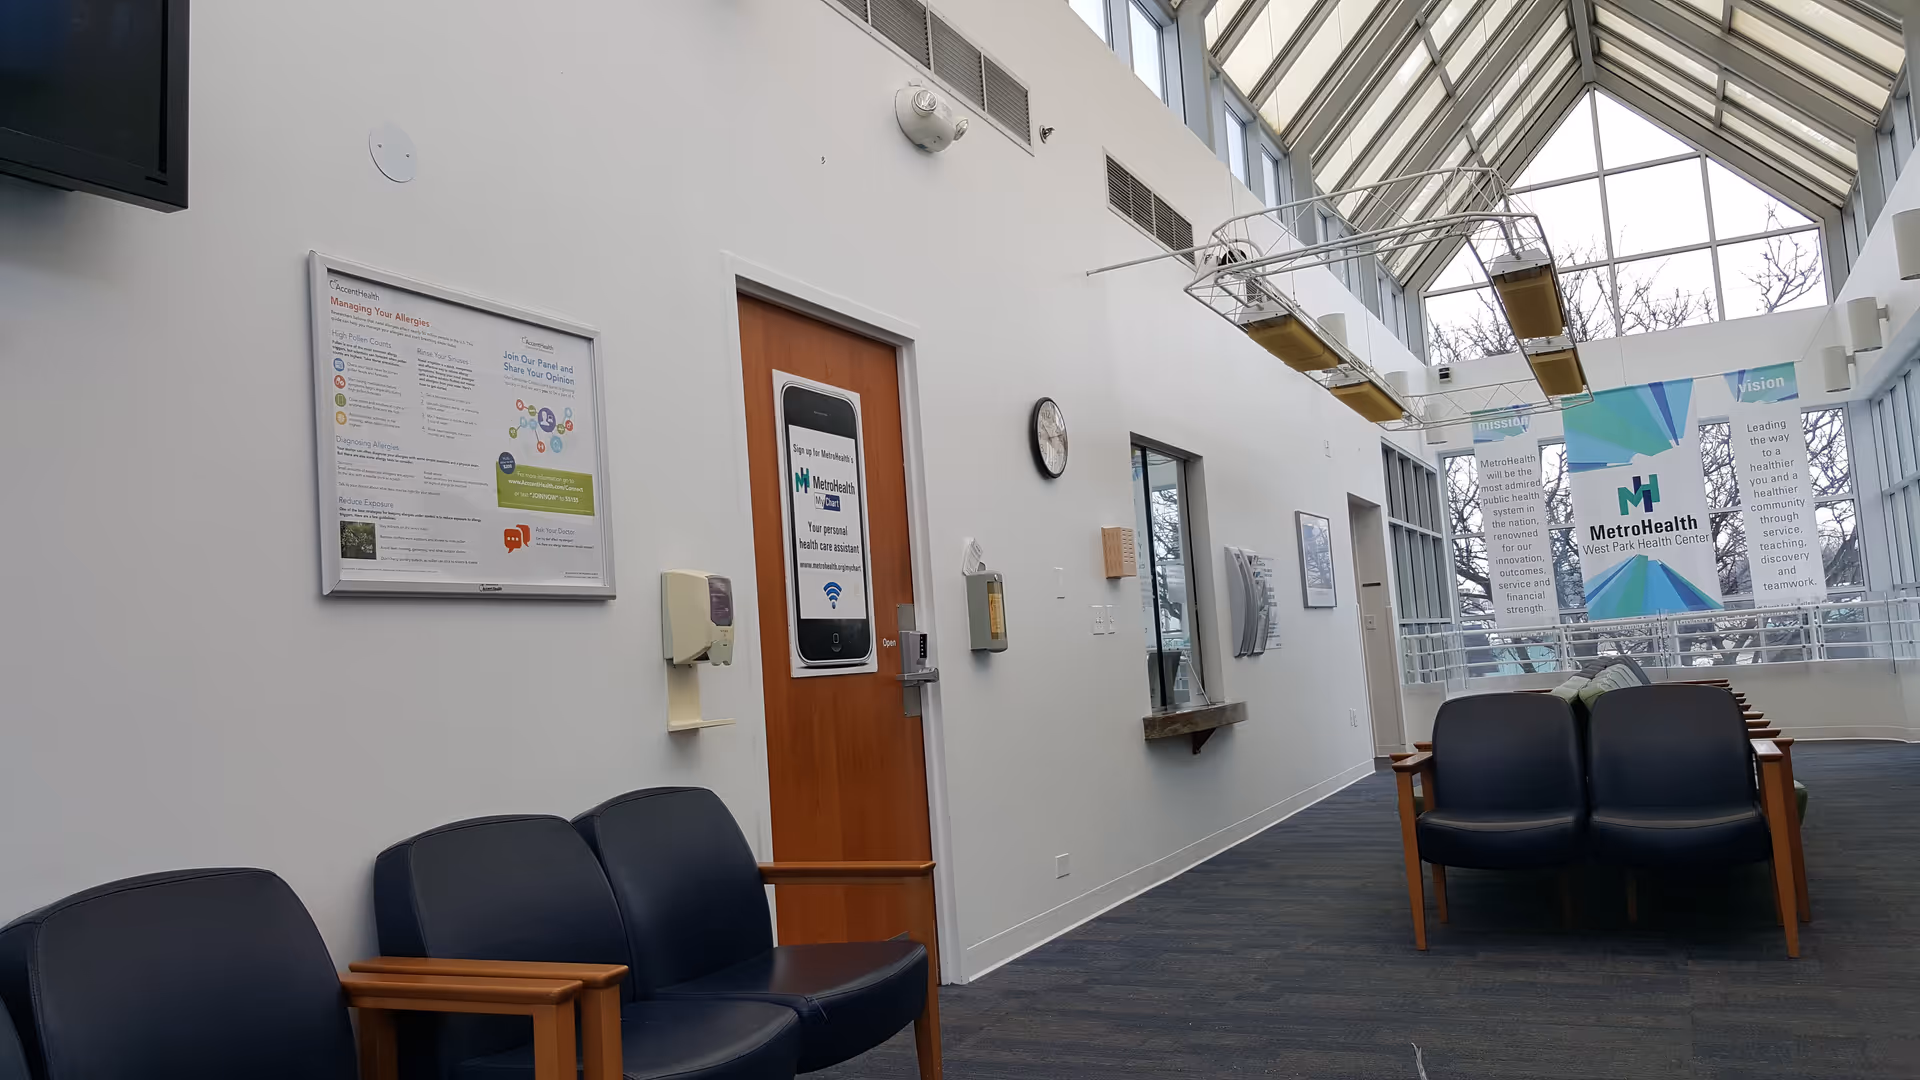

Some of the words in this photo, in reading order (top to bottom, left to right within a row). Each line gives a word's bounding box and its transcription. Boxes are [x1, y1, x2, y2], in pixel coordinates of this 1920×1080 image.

[336, 282, 380, 300] AccentHealth
[330, 296, 372, 316] Managing
[374, 307, 392, 319] Your
[395, 312, 430, 327] Allergies
[332, 330, 347, 340] High
[348, 332, 368, 343] Pollen
[370, 338, 392, 348] Counts
[503, 351, 519, 362] Join
[521, 355, 535, 364] Our
[538, 359, 558, 370] Panel
[504, 362, 524, 374] Share
[526, 368, 544, 378] Your
[546, 372, 574, 385] Opinion
[1739, 377, 1785, 393] vision
[1478, 416, 1528, 431] mission
[1746, 420, 1786, 432] Leading
[1750, 436, 1766, 446] the
[1768, 434, 1790, 442] way
[793, 444, 804, 456] Sign
[806, 448, 812, 457] up
[821, 450, 854, 464] MetroHealth's
[1762, 449, 1772, 458] to
[1480, 455, 1536, 468] MetroHealth
[1750, 459, 1795, 472] healthier
[1486, 471, 1502, 480] will
[1504, 470, 1516, 478] be
[1518, 468, 1532, 476] the
[1750, 476, 1768, 487] you
[1770, 472, 1790, 483] and
[812, 476, 855, 495] MetroHealth
[1481, 484, 1502, 492] most
[1505, 479, 1541, 488] admired
[1754, 486, 1798, 498] healthier
[339, 497, 362, 506] Reduce
[364, 499, 394, 508] Exposure
[1483, 495, 1510, 506] public
[1512, 492, 1540, 500] health
[1750, 498, 1806, 512] community
[1493, 507, 1524, 517] system
[1760, 512, 1799, 524] through
[808, 521, 822, 533] Your
[824, 526, 848, 536] personal
[1590, 514, 1698, 540] MetroHealth
[1494, 530, 1538, 540] renowned
[799, 538, 818, 550] health
[820, 543, 832, 552] care
[834, 542, 860, 554] assistant
[1502, 544, 1514, 552] for
[1583, 544, 1610, 555] West
[1612, 540, 1636, 552] Park
[1638, 536, 1672, 550] Health
[1674, 534, 1710, 546] Center
[1760, 552, 1810, 564] discovery
[1778, 565, 1796, 576] and
[1498, 580, 1531, 590] service
[1534, 578, 1550, 586] and
[1506, 591, 1546, 601] financial
[882, 638, 896, 648] Open
